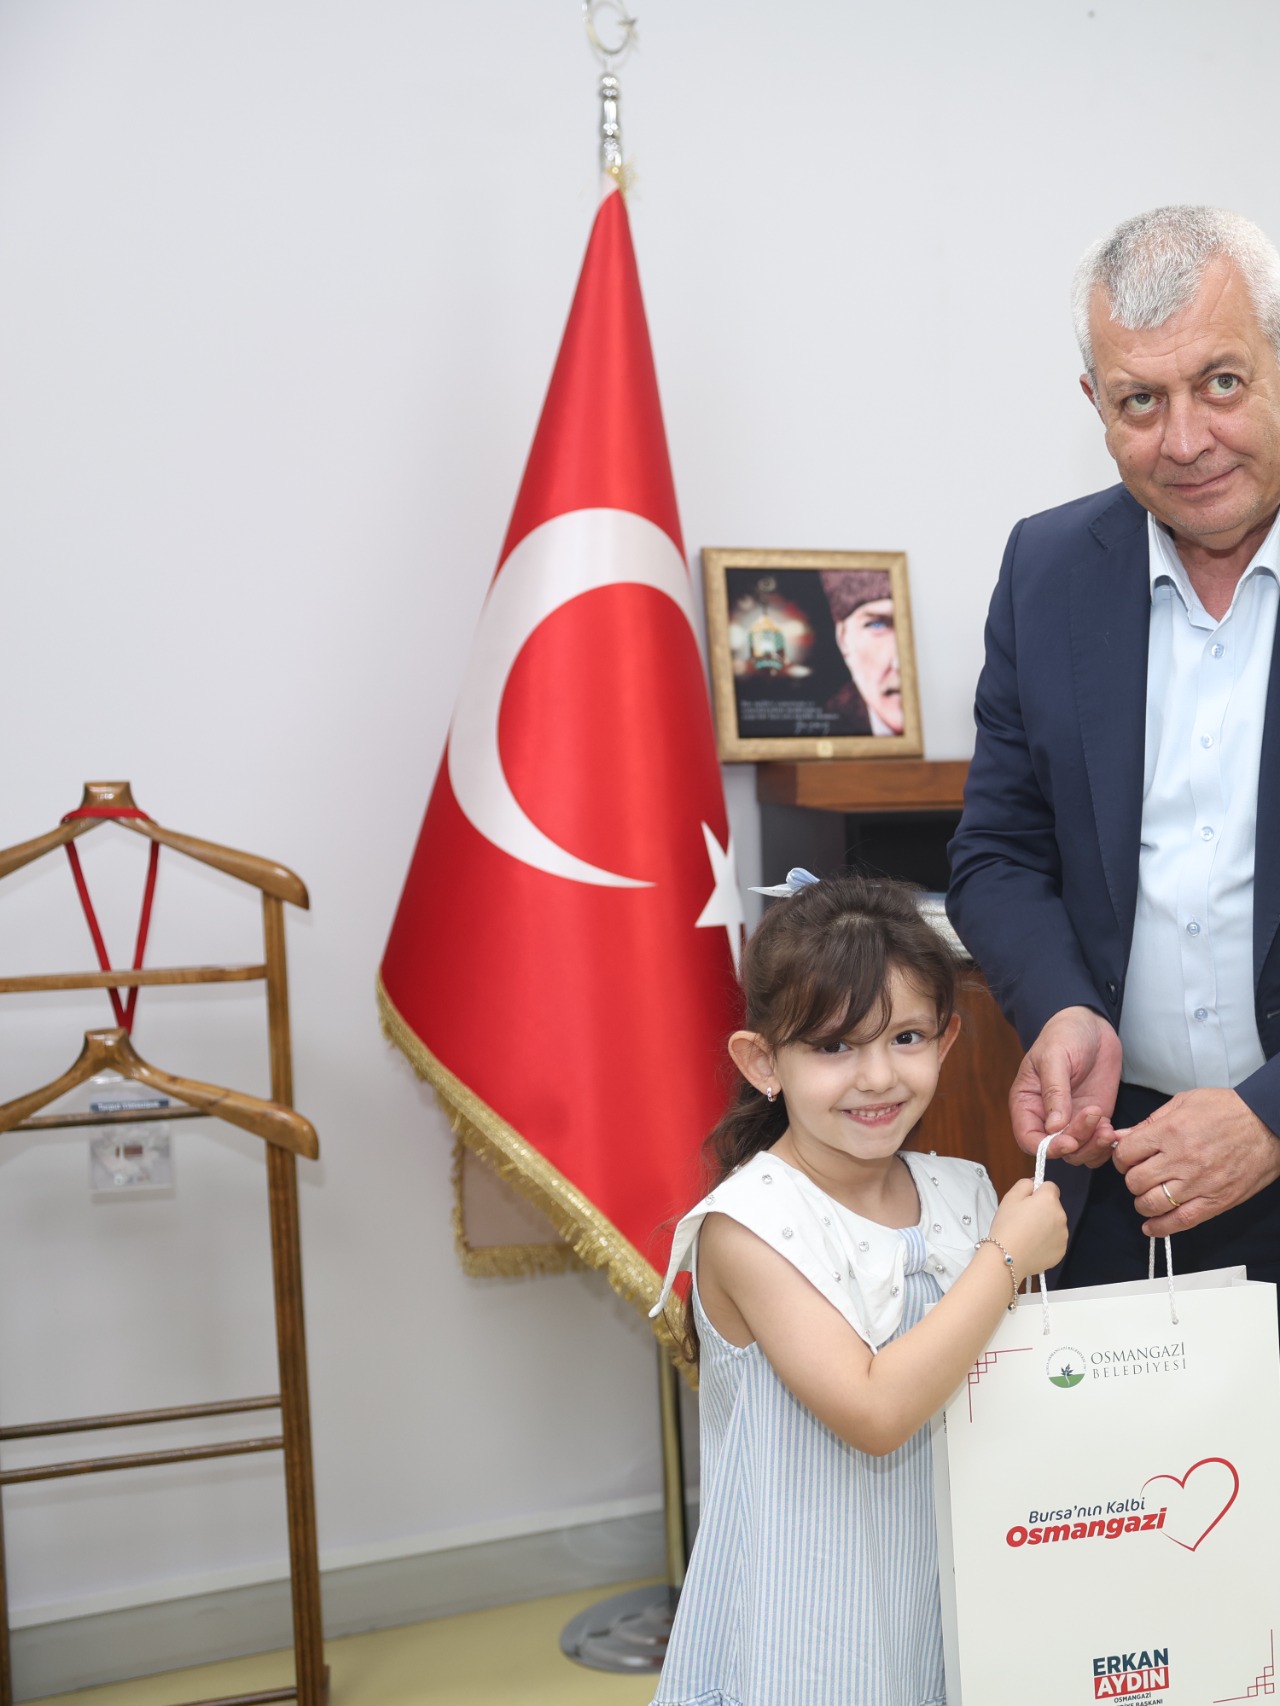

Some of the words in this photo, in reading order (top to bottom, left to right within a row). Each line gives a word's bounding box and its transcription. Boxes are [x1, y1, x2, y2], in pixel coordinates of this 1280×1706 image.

[1090, 1341, 1185, 1364] OSMANGAZİ
[1093, 1358, 1187, 1379] BELEDİYESİ
[1106, 1497, 1145, 1514] Kalbi
[1006, 1507, 1167, 1548] Osmangazi
[1093, 1648, 1169, 1676] ERKAN
[1097, 1668, 1166, 1697] AYDIN
[1113, 1692, 1152, 1703] OSMANGAZİ
